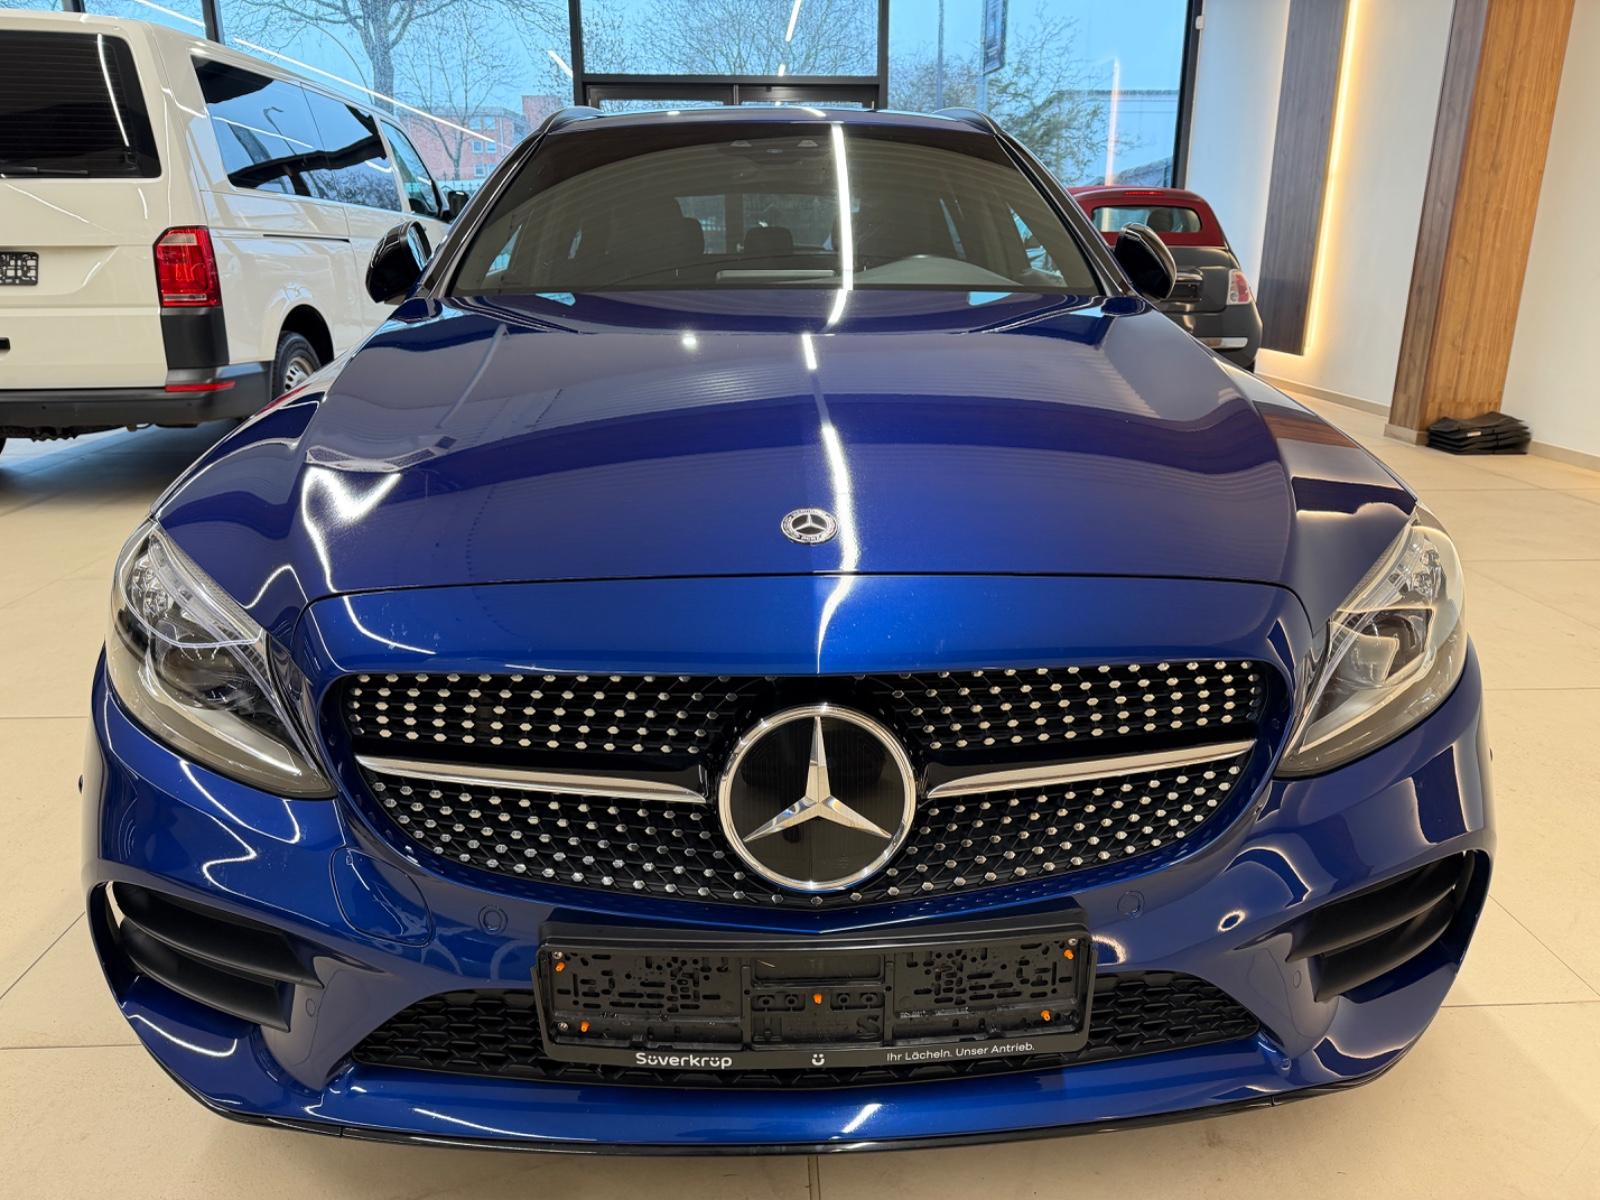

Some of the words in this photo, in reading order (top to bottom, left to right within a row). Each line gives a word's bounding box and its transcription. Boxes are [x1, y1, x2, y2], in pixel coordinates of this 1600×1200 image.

[886, 1053, 901, 1061] Ihr
[904, 1049, 953, 1061] Lächeln.
[955, 1047, 989, 1057] Unser
[990, 1041, 1035, 1054] Antrieb.
[635, 1052, 733, 1070] Süverkrüp
